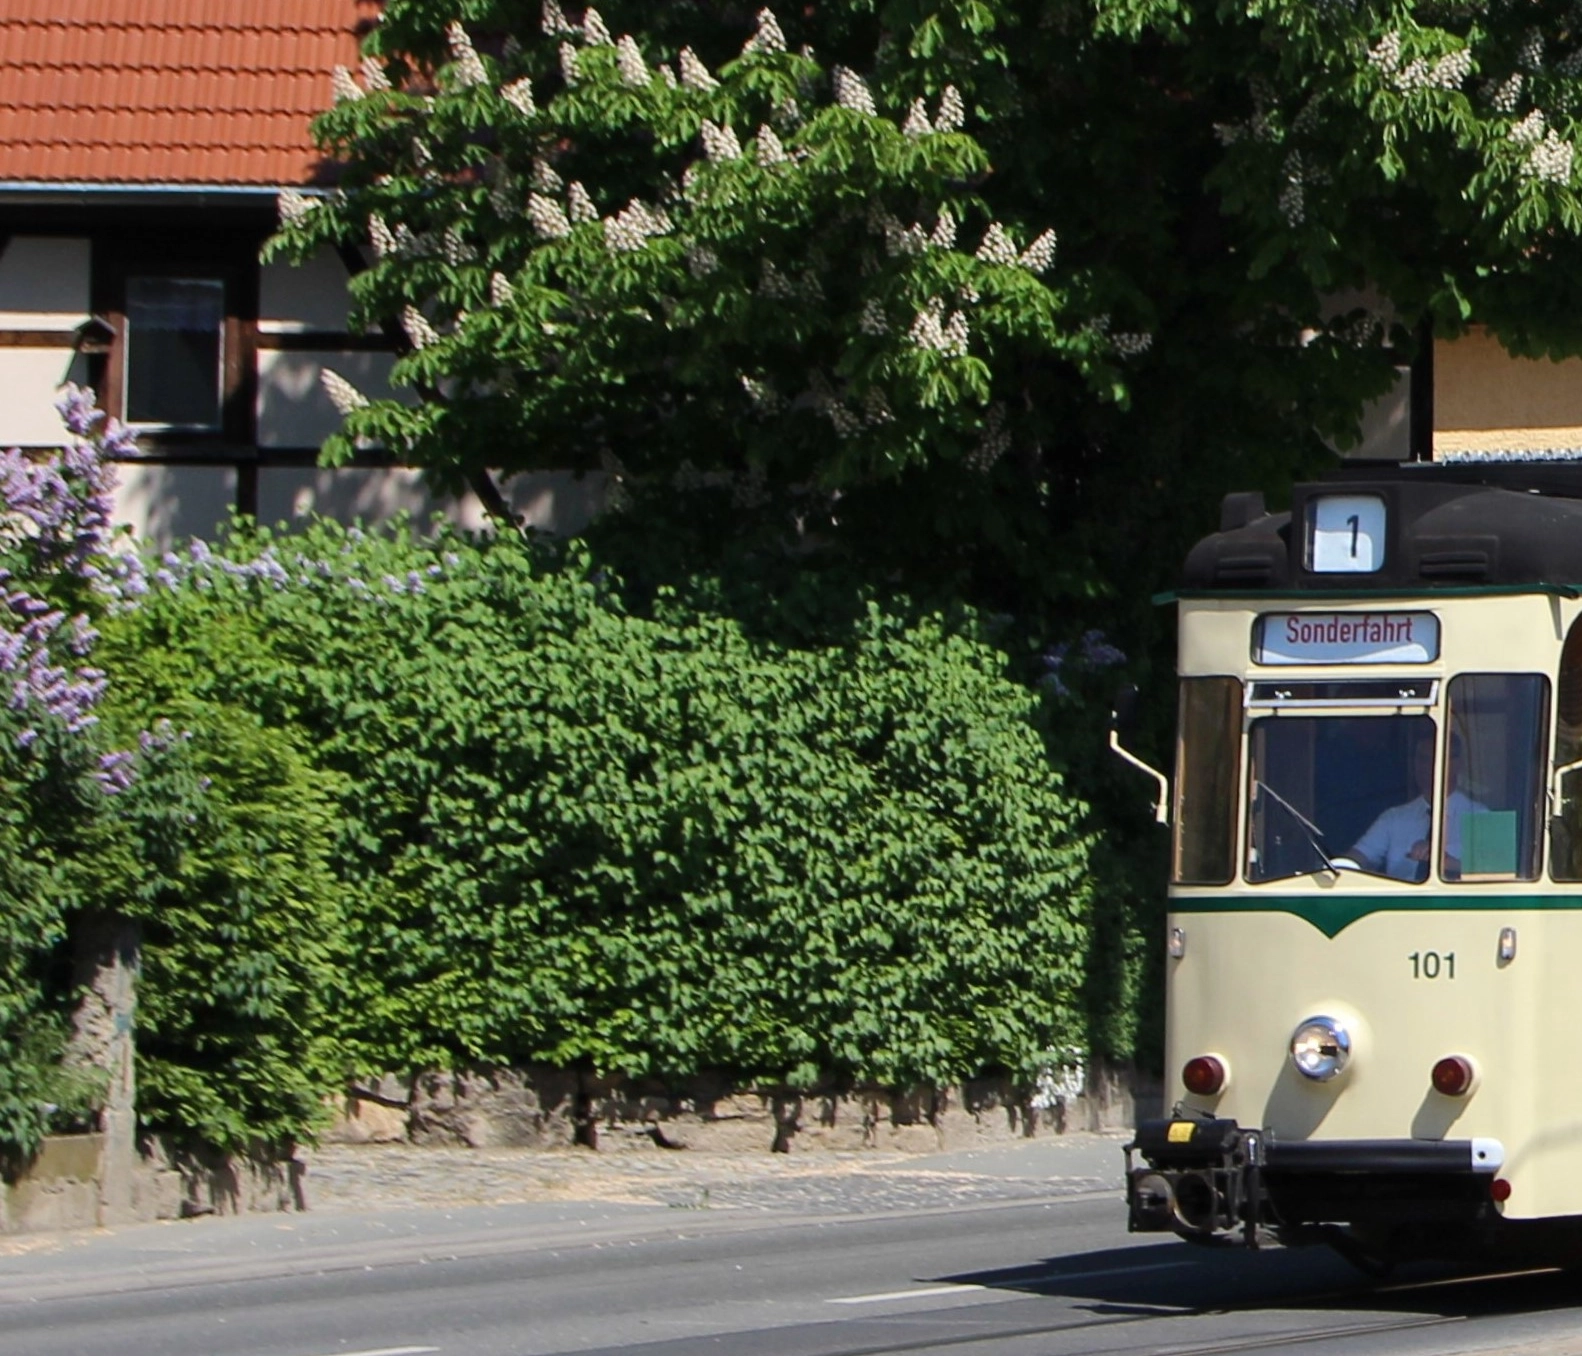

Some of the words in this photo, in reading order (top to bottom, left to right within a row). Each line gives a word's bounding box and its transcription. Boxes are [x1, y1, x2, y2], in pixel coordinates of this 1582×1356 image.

[1346, 514, 1359, 558] 1
[1286, 614, 1413, 643] Sonderfahrt
[1408, 951, 1455, 979] 101
